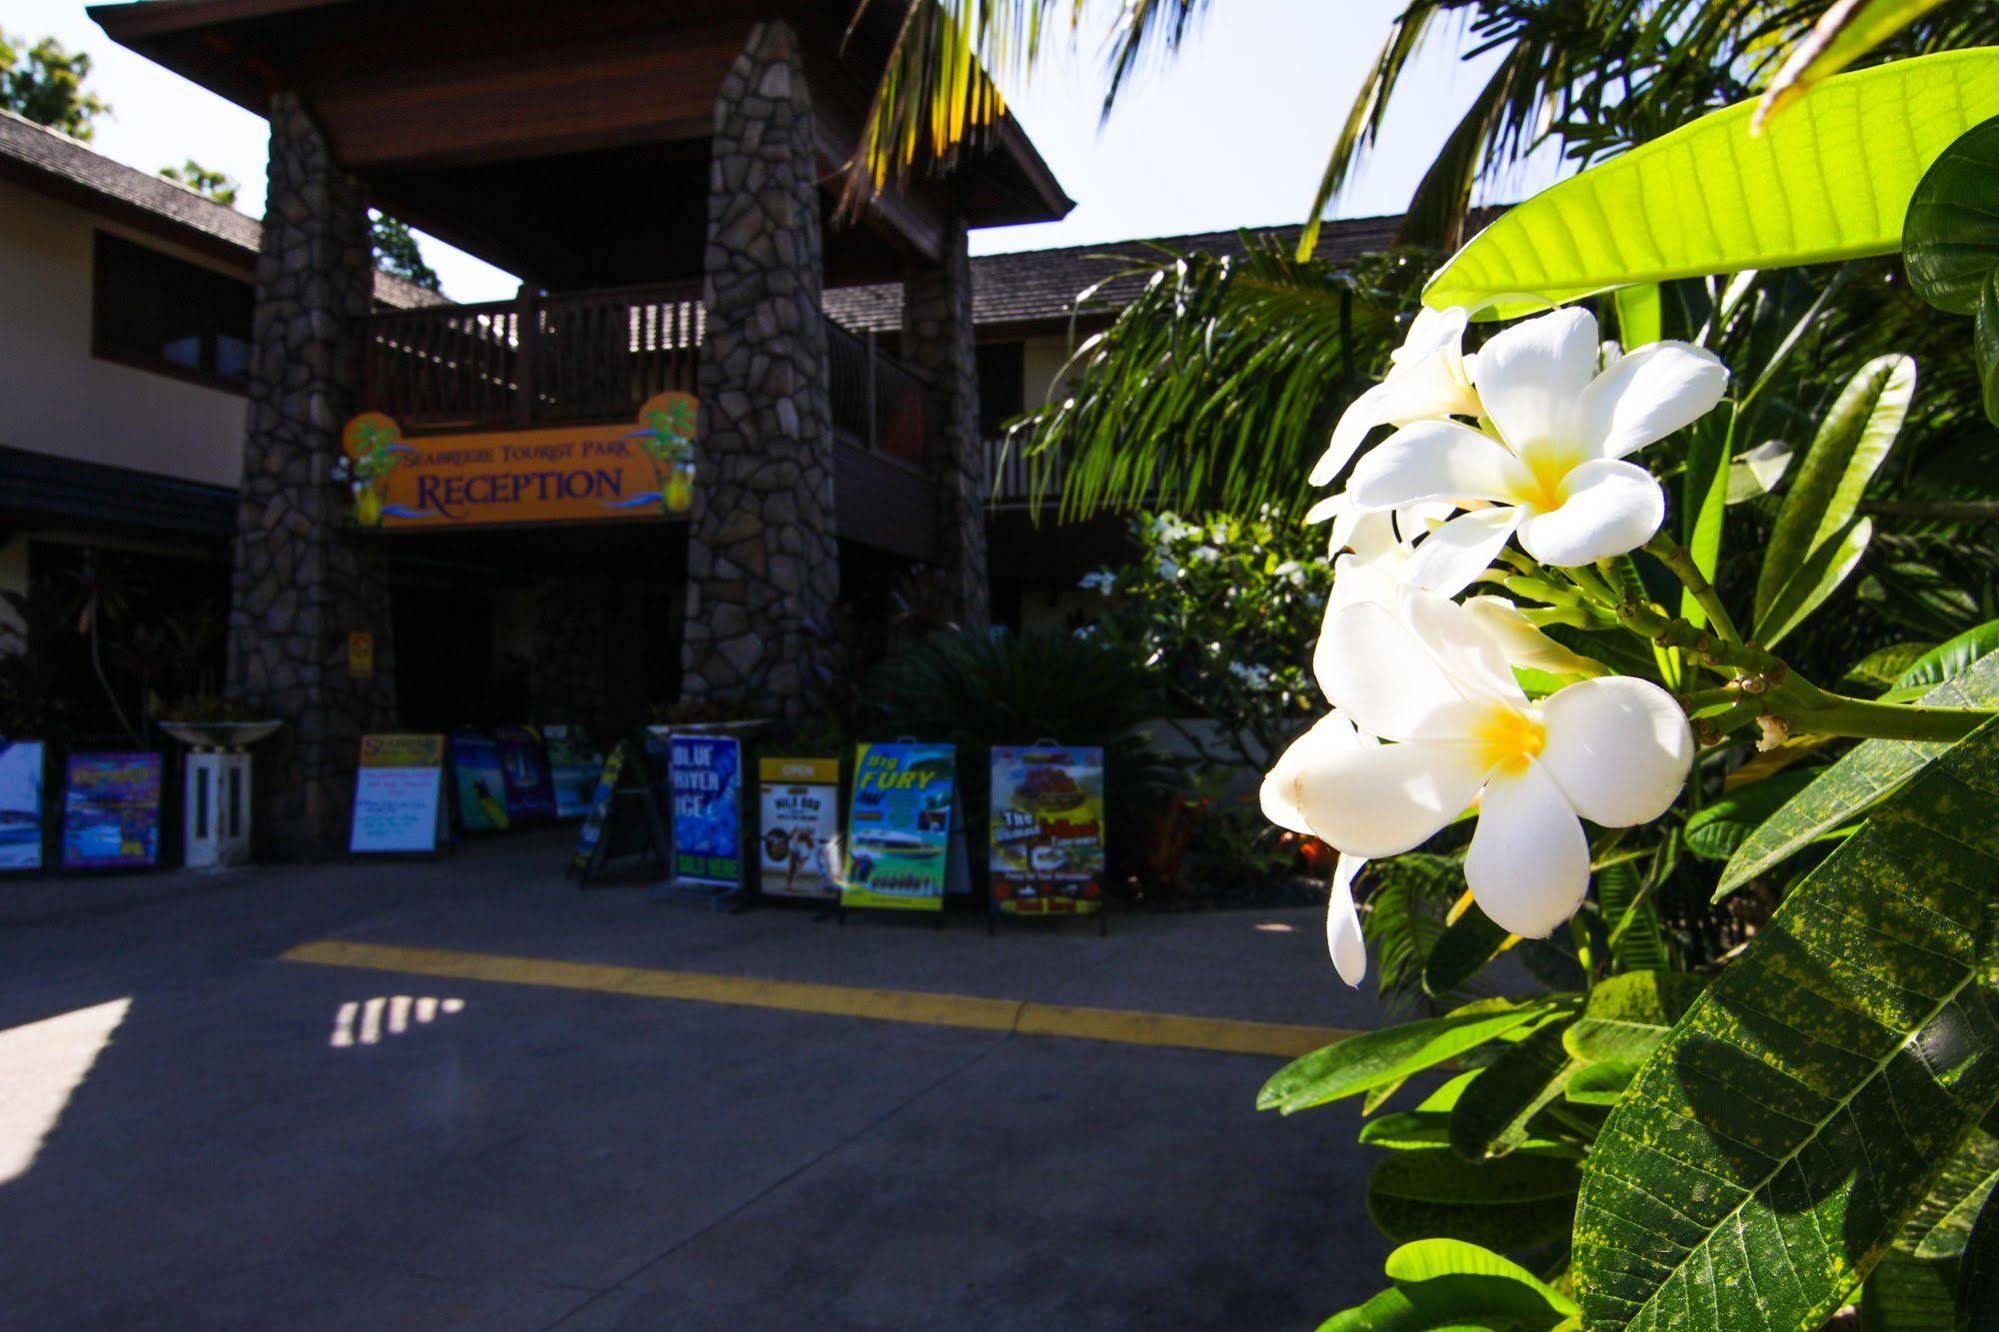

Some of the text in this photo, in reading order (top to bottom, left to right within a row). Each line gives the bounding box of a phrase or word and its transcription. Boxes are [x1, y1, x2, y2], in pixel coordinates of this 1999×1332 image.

[501, 443, 575, 462] TOURIST
[582, 440, 633, 458] PARK
[417, 468, 624, 520] RECEPTION
[860, 771, 936, 789] FURY
